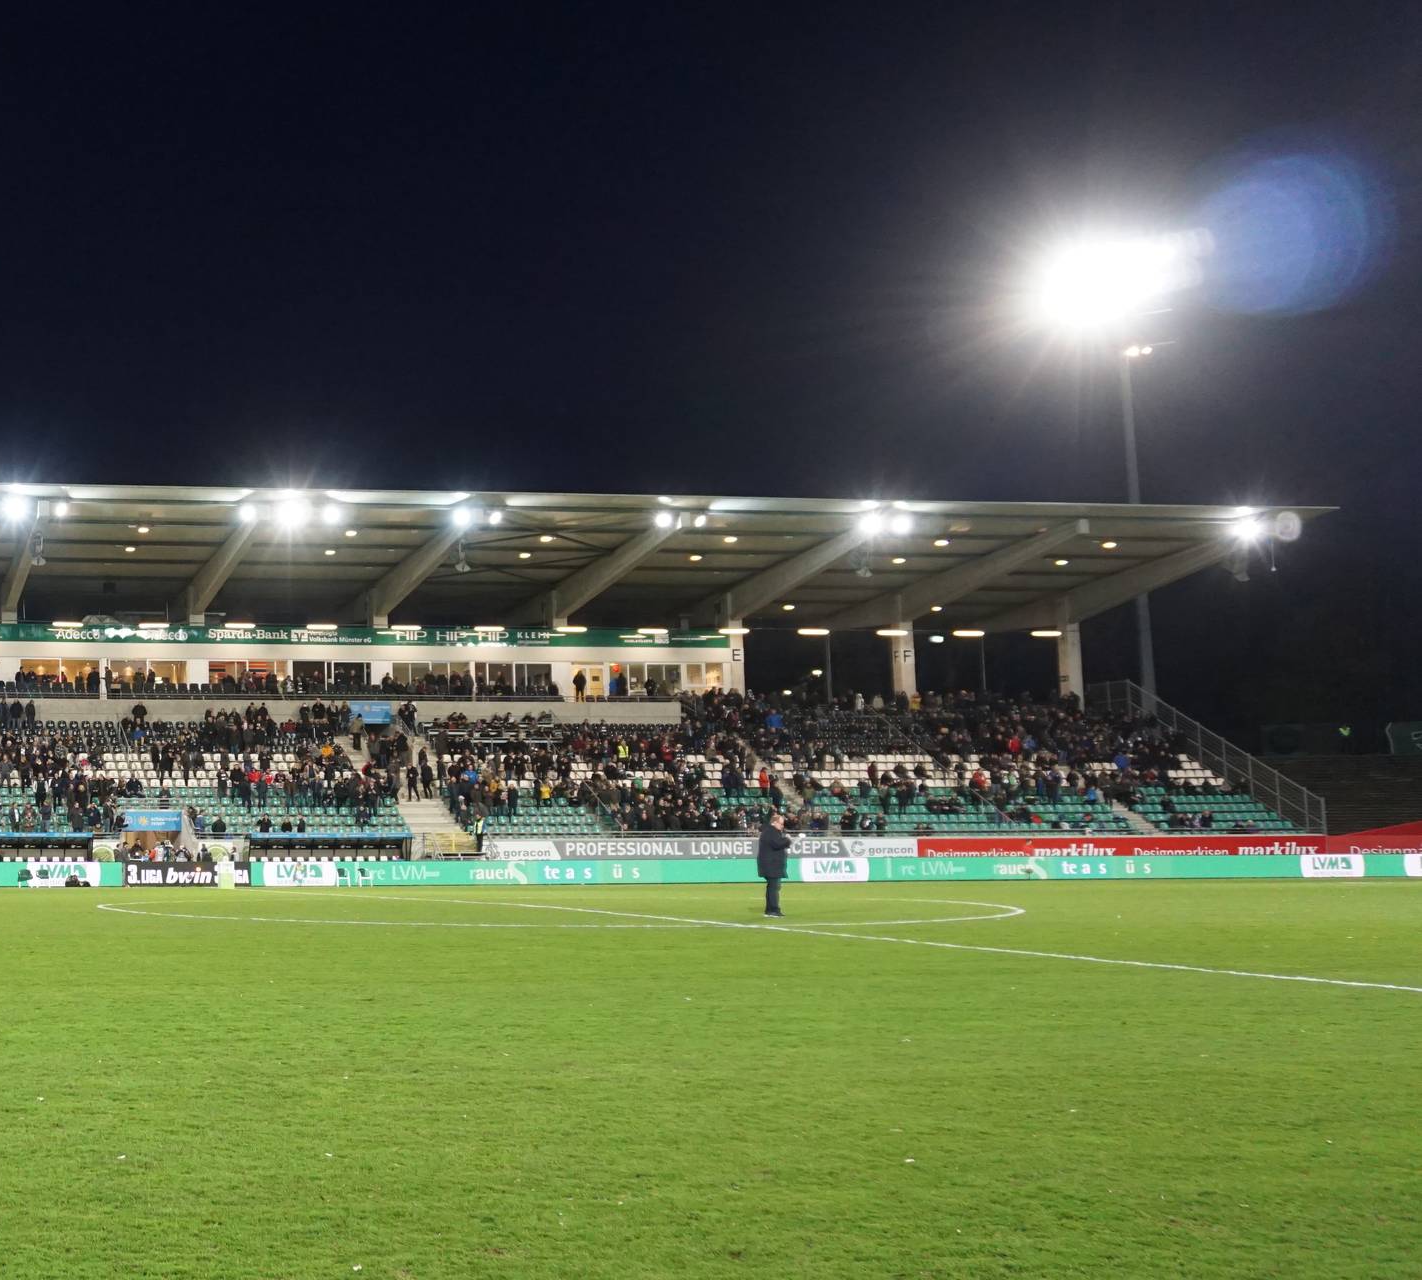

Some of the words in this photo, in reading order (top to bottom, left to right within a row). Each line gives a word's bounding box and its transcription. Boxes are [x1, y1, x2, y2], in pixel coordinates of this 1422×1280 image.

[208, 628, 289, 641] Sparda-Bank
[395, 630, 428, 641] HIP
[436, 631, 467, 641] HIP
[478, 631, 509, 641] HIP
[516, 631, 551, 639] KLEIN
[731, 648, 741, 662] E
[903, 650, 914, 665] F
[503, 848, 551, 859] goracon
[565, 842, 683, 856] PROFESSIONAL
[691, 841, 753, 855] LOUNGE
[787, 840, 840, 854] CEPTS
[868, 846, 914, 856] goracon
[1034, 843, 1116, 857] markilux
[1134, 846, 1229, 856] Designmarkisen
[1237, 841, 1319, 855] markilux
[813, 860, 845, 874] LVM
[1312, 856, 1340, 870] LVM
[127, 864, 141, 883] 3.
[141, 868, 163, 883] LIGA
[165, 867, 213, 884] bwin
